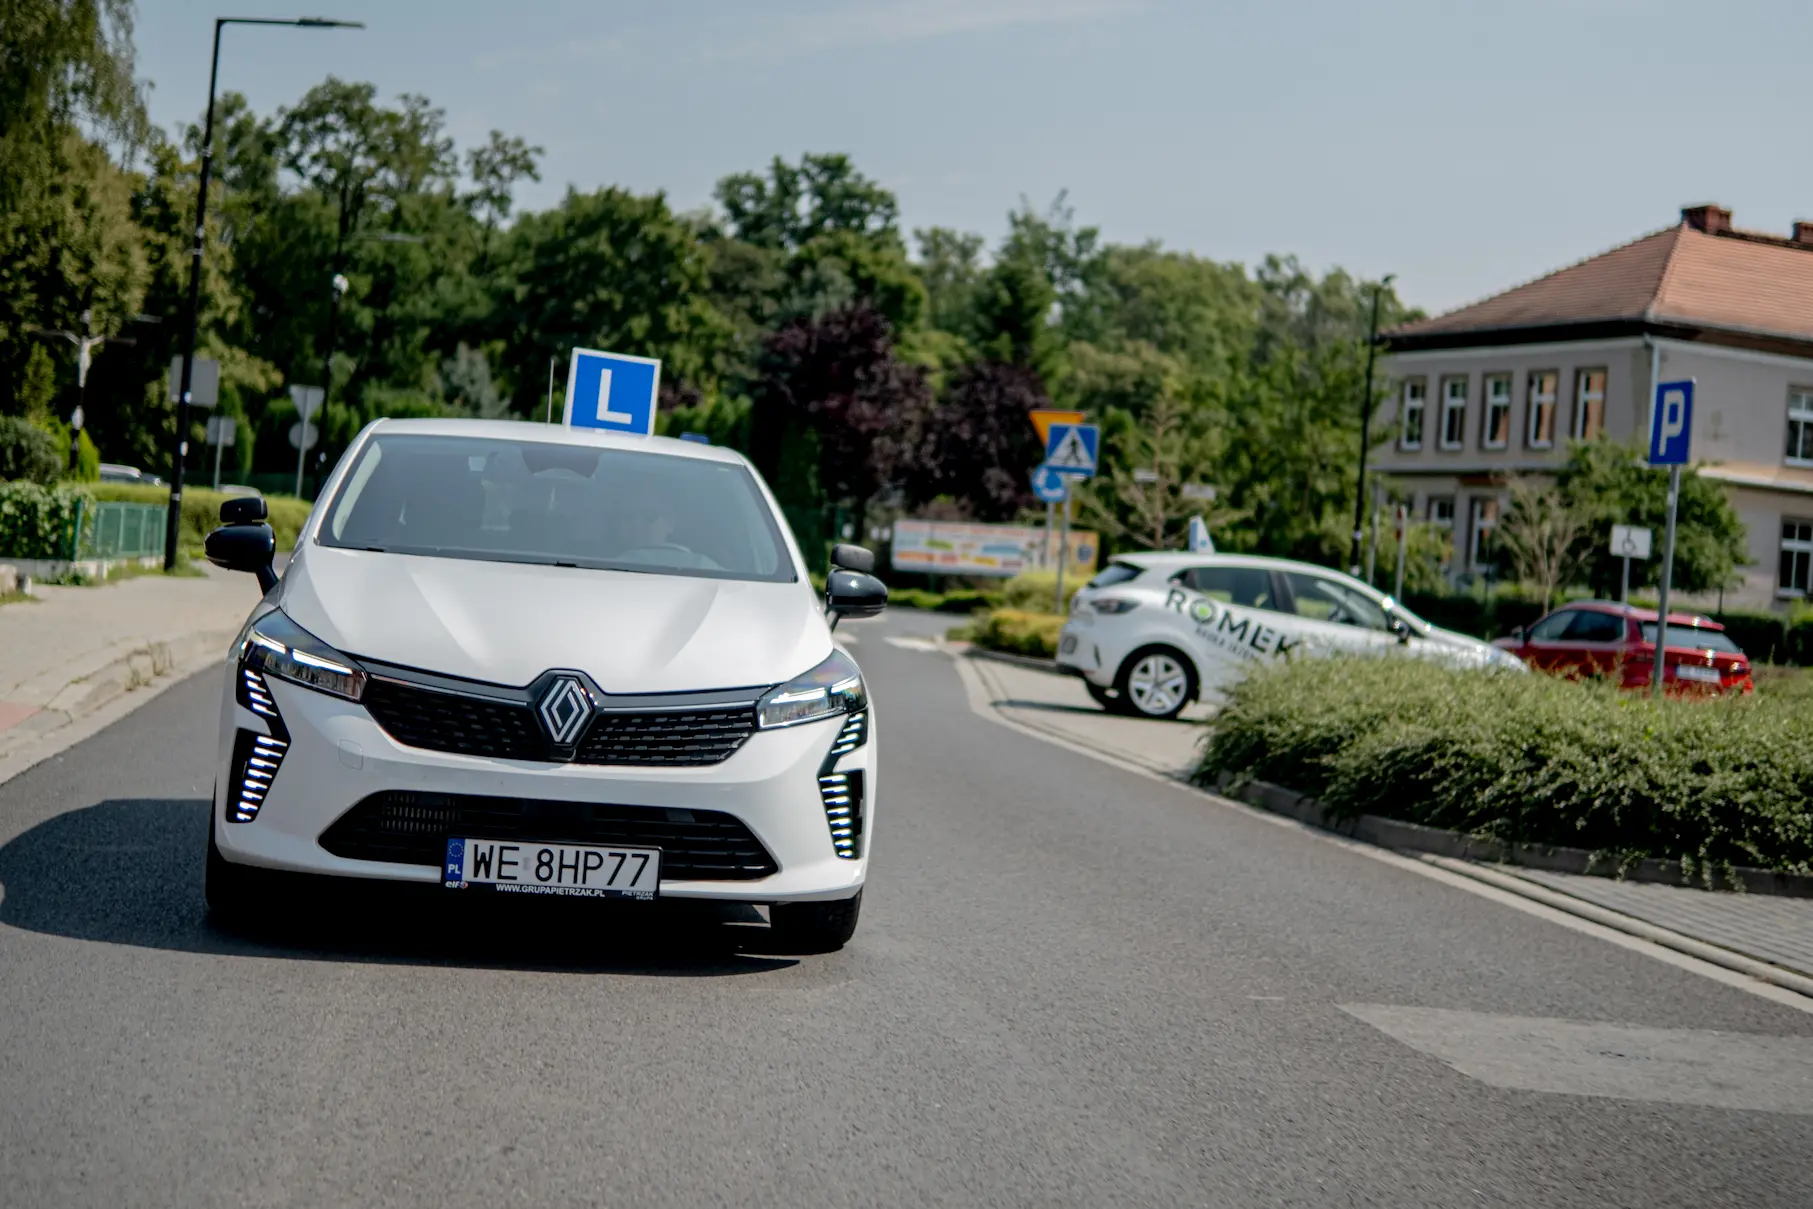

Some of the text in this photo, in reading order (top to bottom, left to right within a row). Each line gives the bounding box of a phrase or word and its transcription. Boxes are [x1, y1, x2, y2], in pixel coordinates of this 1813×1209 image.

[596, 368, 632, 425] L
[1659, 390, 1685, 456] P
[1165, 587, 1300, 657] ROMEK
[448, 864, 461, 875] PL
[473, 844, 650, 887] WE 8HP77
[496, 884, 605, 898] WWW.GRUPAPIETRZAK.PL
